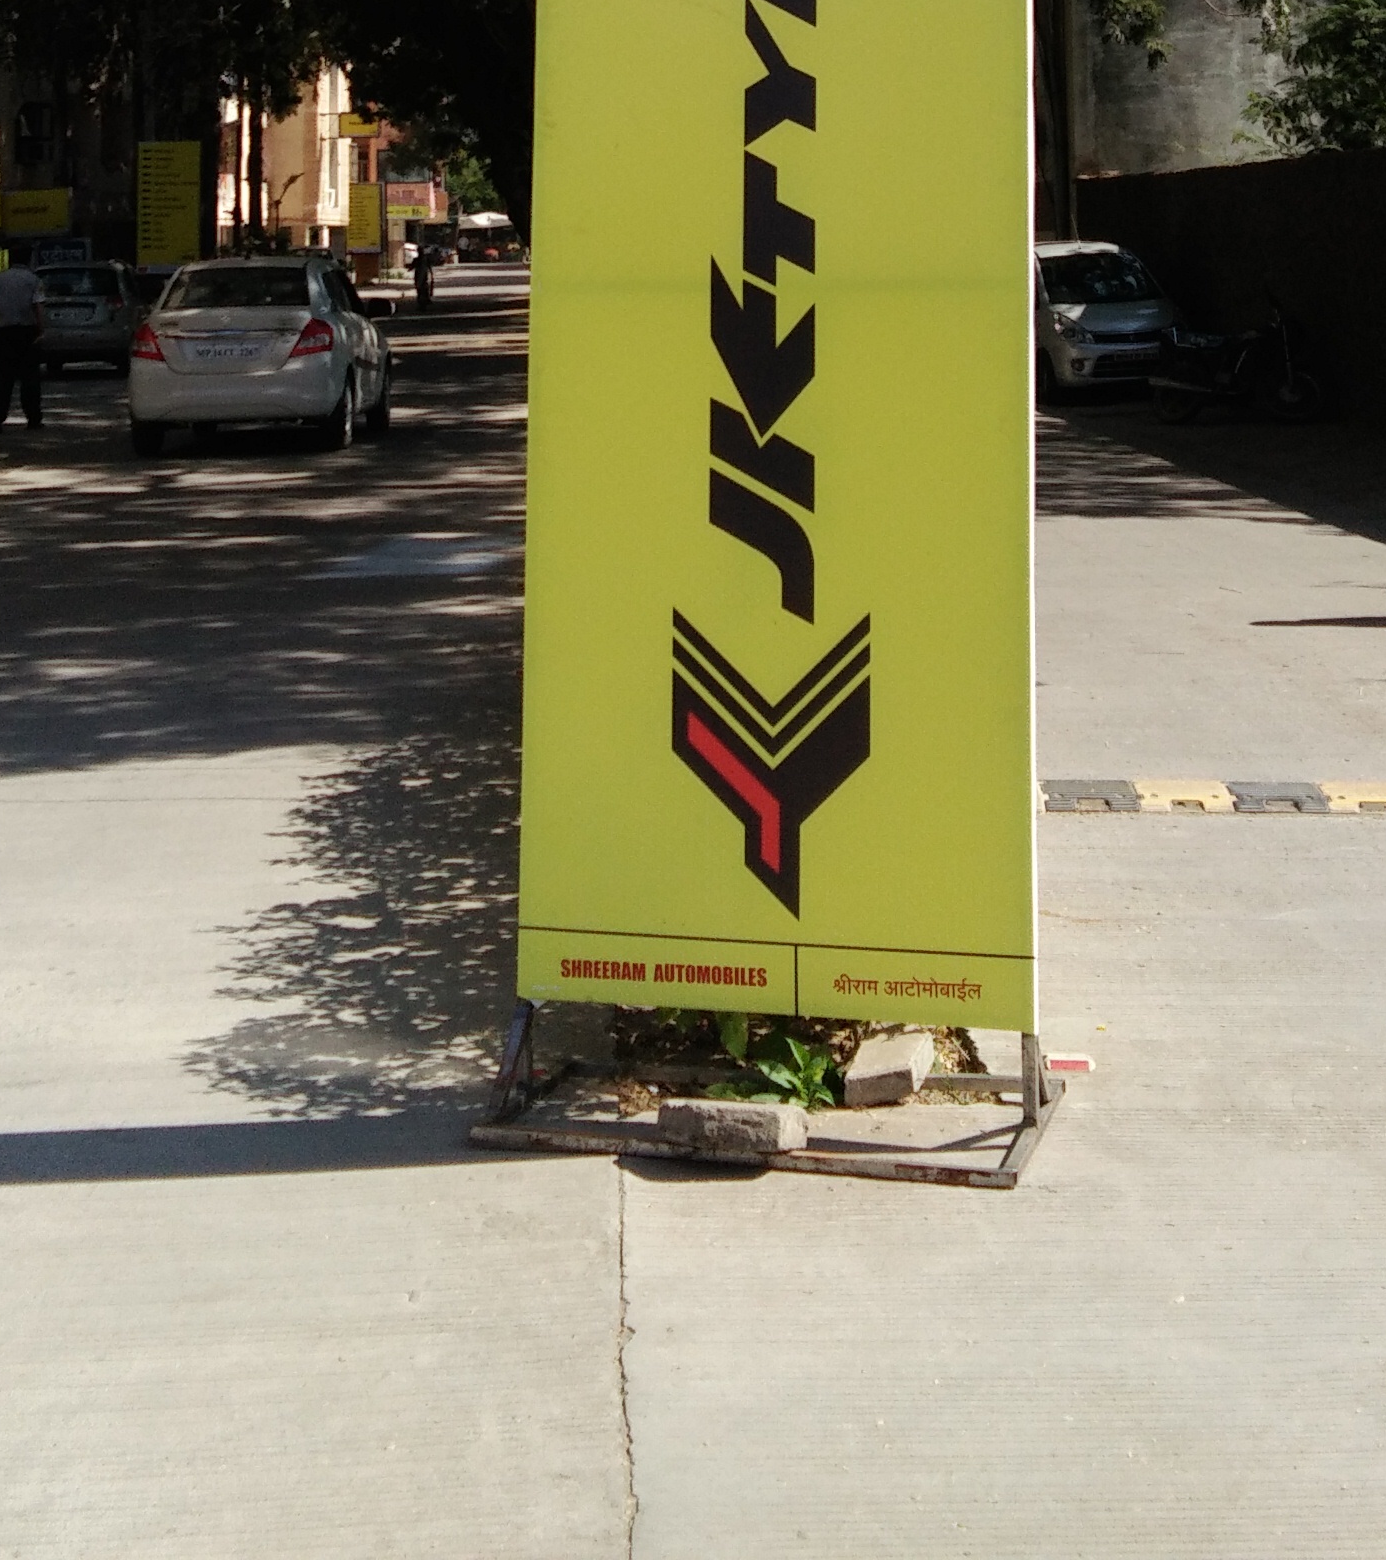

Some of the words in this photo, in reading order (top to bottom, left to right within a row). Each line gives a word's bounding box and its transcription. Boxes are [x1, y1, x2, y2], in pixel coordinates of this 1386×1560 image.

[560, 958, 646, 982] SHREERAM
[653, 962, 767, 988] AUTOMOBILES
[832, 972, 879, 996] श्रीराम
